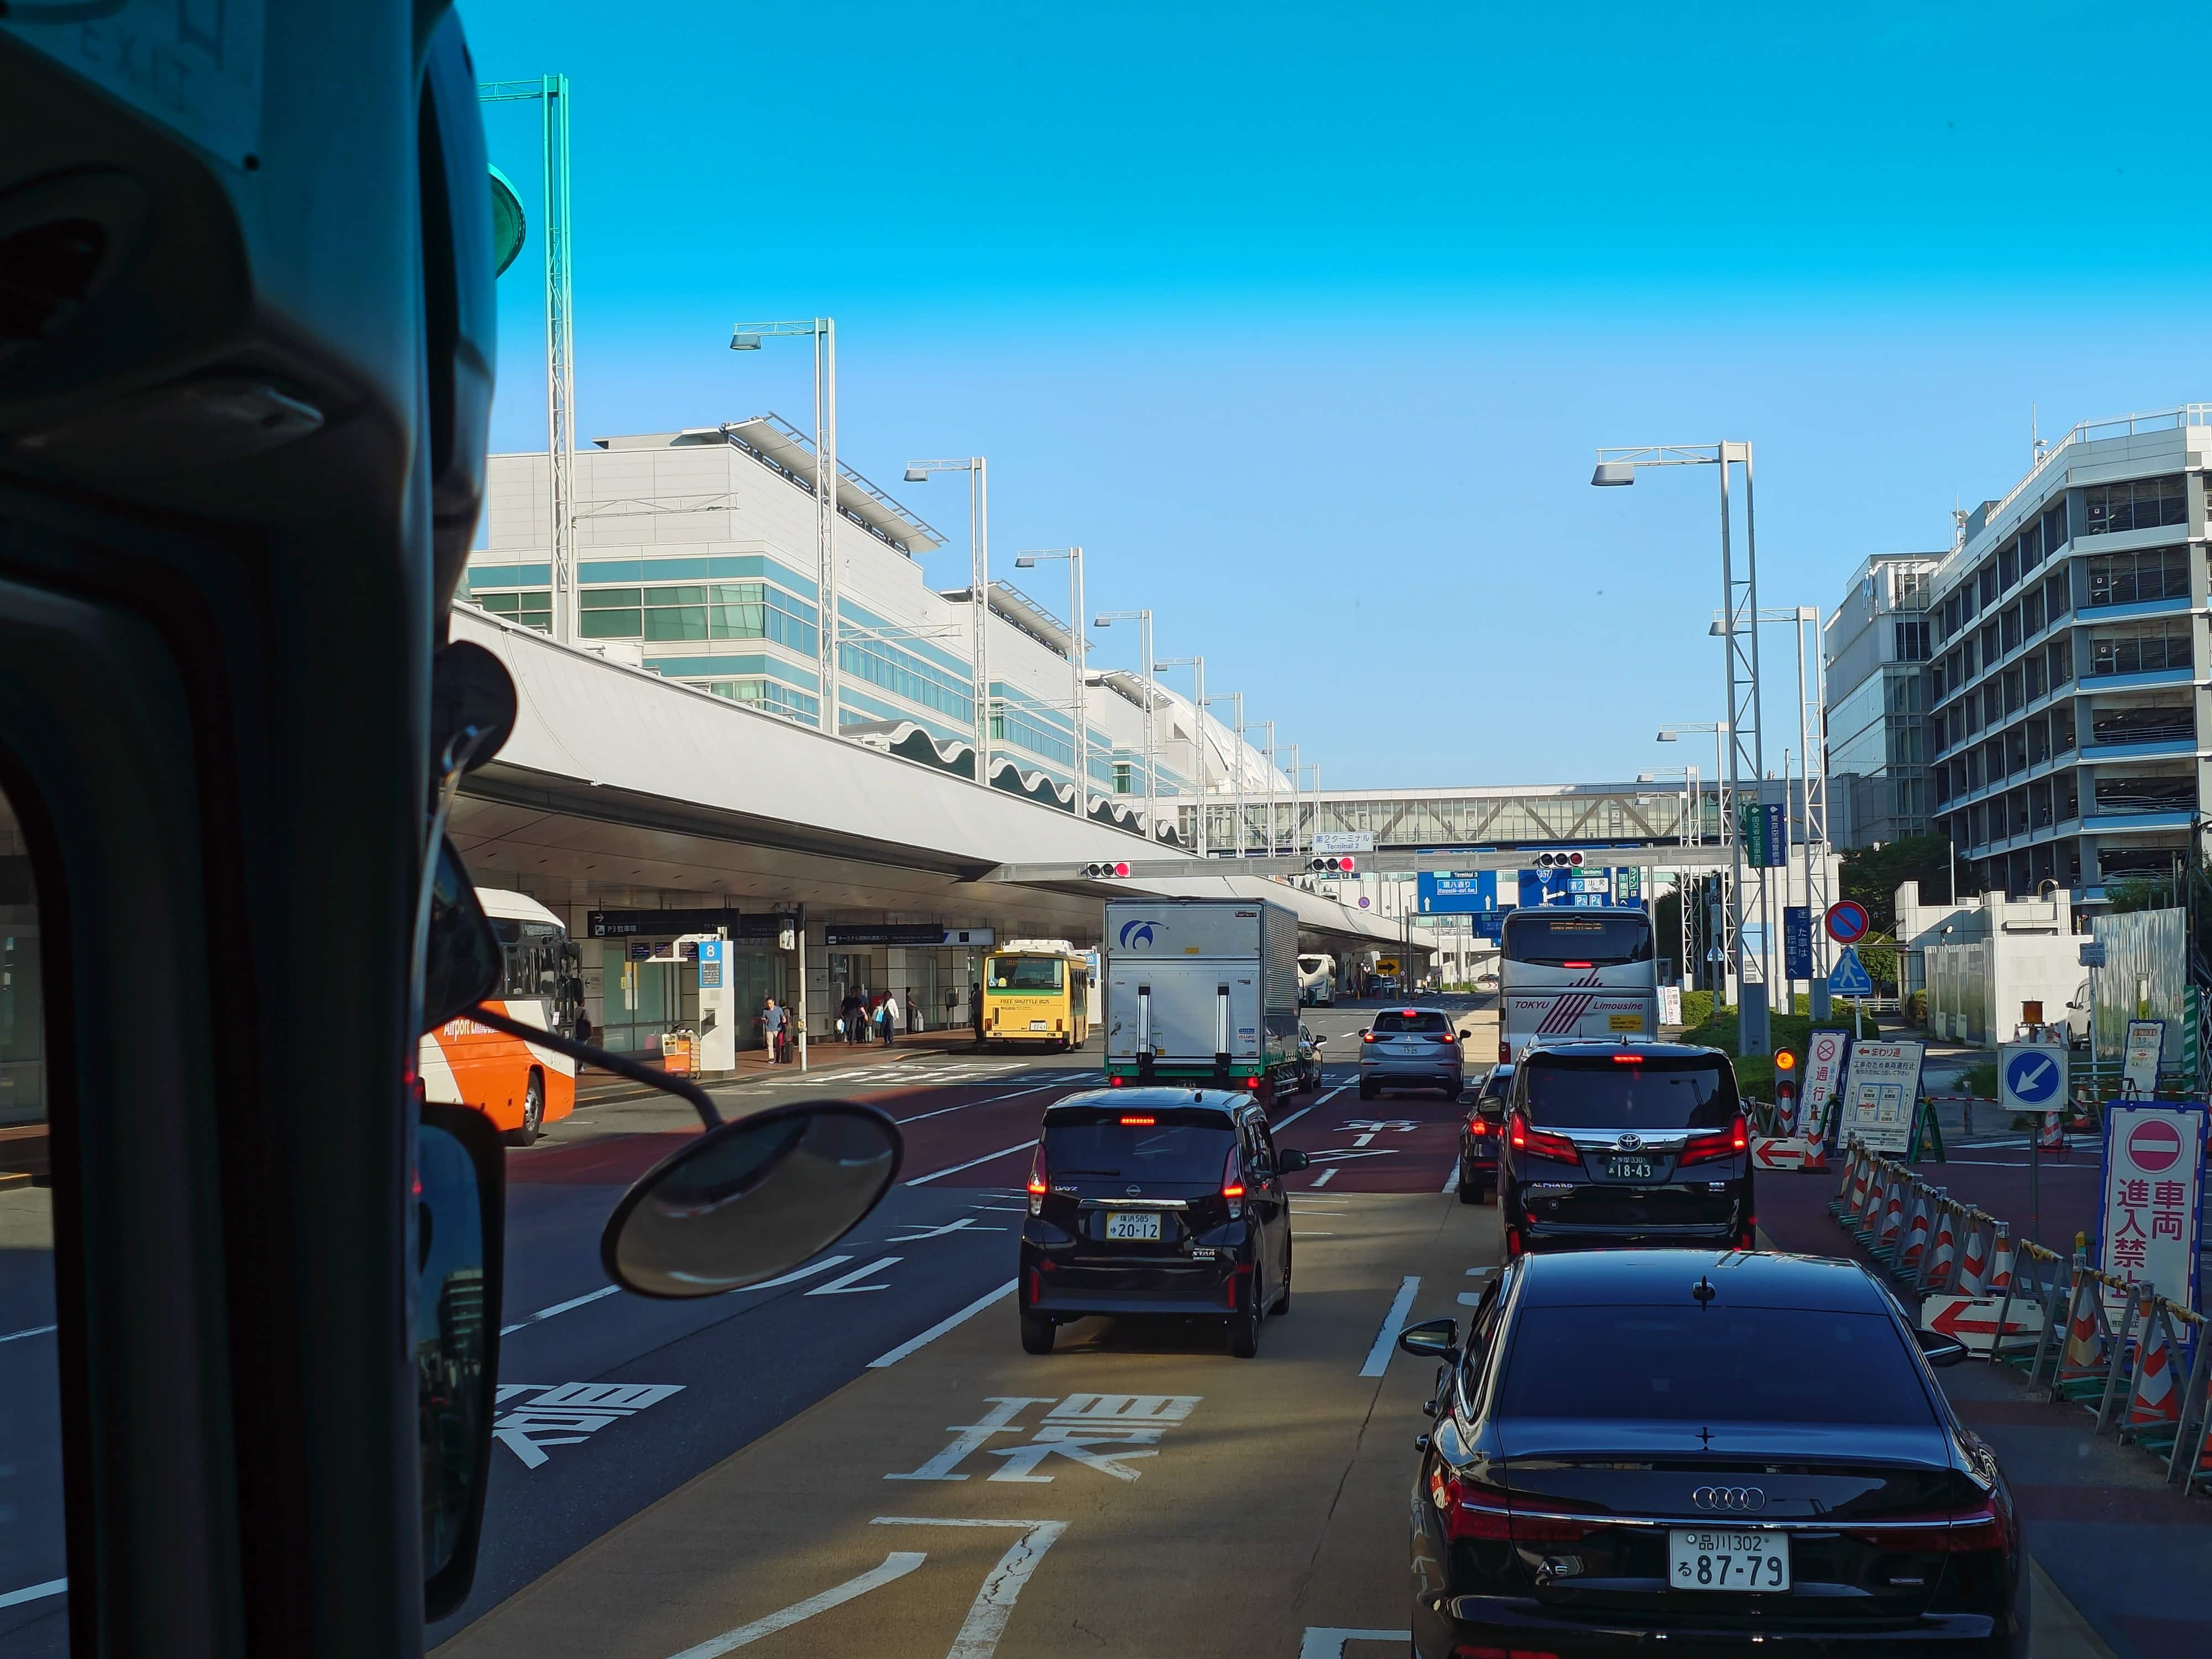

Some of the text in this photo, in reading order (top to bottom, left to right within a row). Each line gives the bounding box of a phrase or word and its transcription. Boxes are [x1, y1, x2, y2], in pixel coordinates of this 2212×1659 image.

[1316, 834, 1370, 843] 第2ターミナル
[1591, 896, 1600, 906] P4
[707, 945, 714, 957] 8
[1593, 1001, 1643, 1010] Limousine
[444, 1019, 470, 1042] Airport
[1871, 1048, 1901, 1057] まわり道
[1618, 1164, 1651, 1178] 18-43
[2152, 1180, 2186, 1241] 車両
[1118, 1224, 1158, 1238] 20-12
[2111, 1179, 2150, 1298] 進入禁止
[1678, 1554, 1782, 1587] る 87-79
